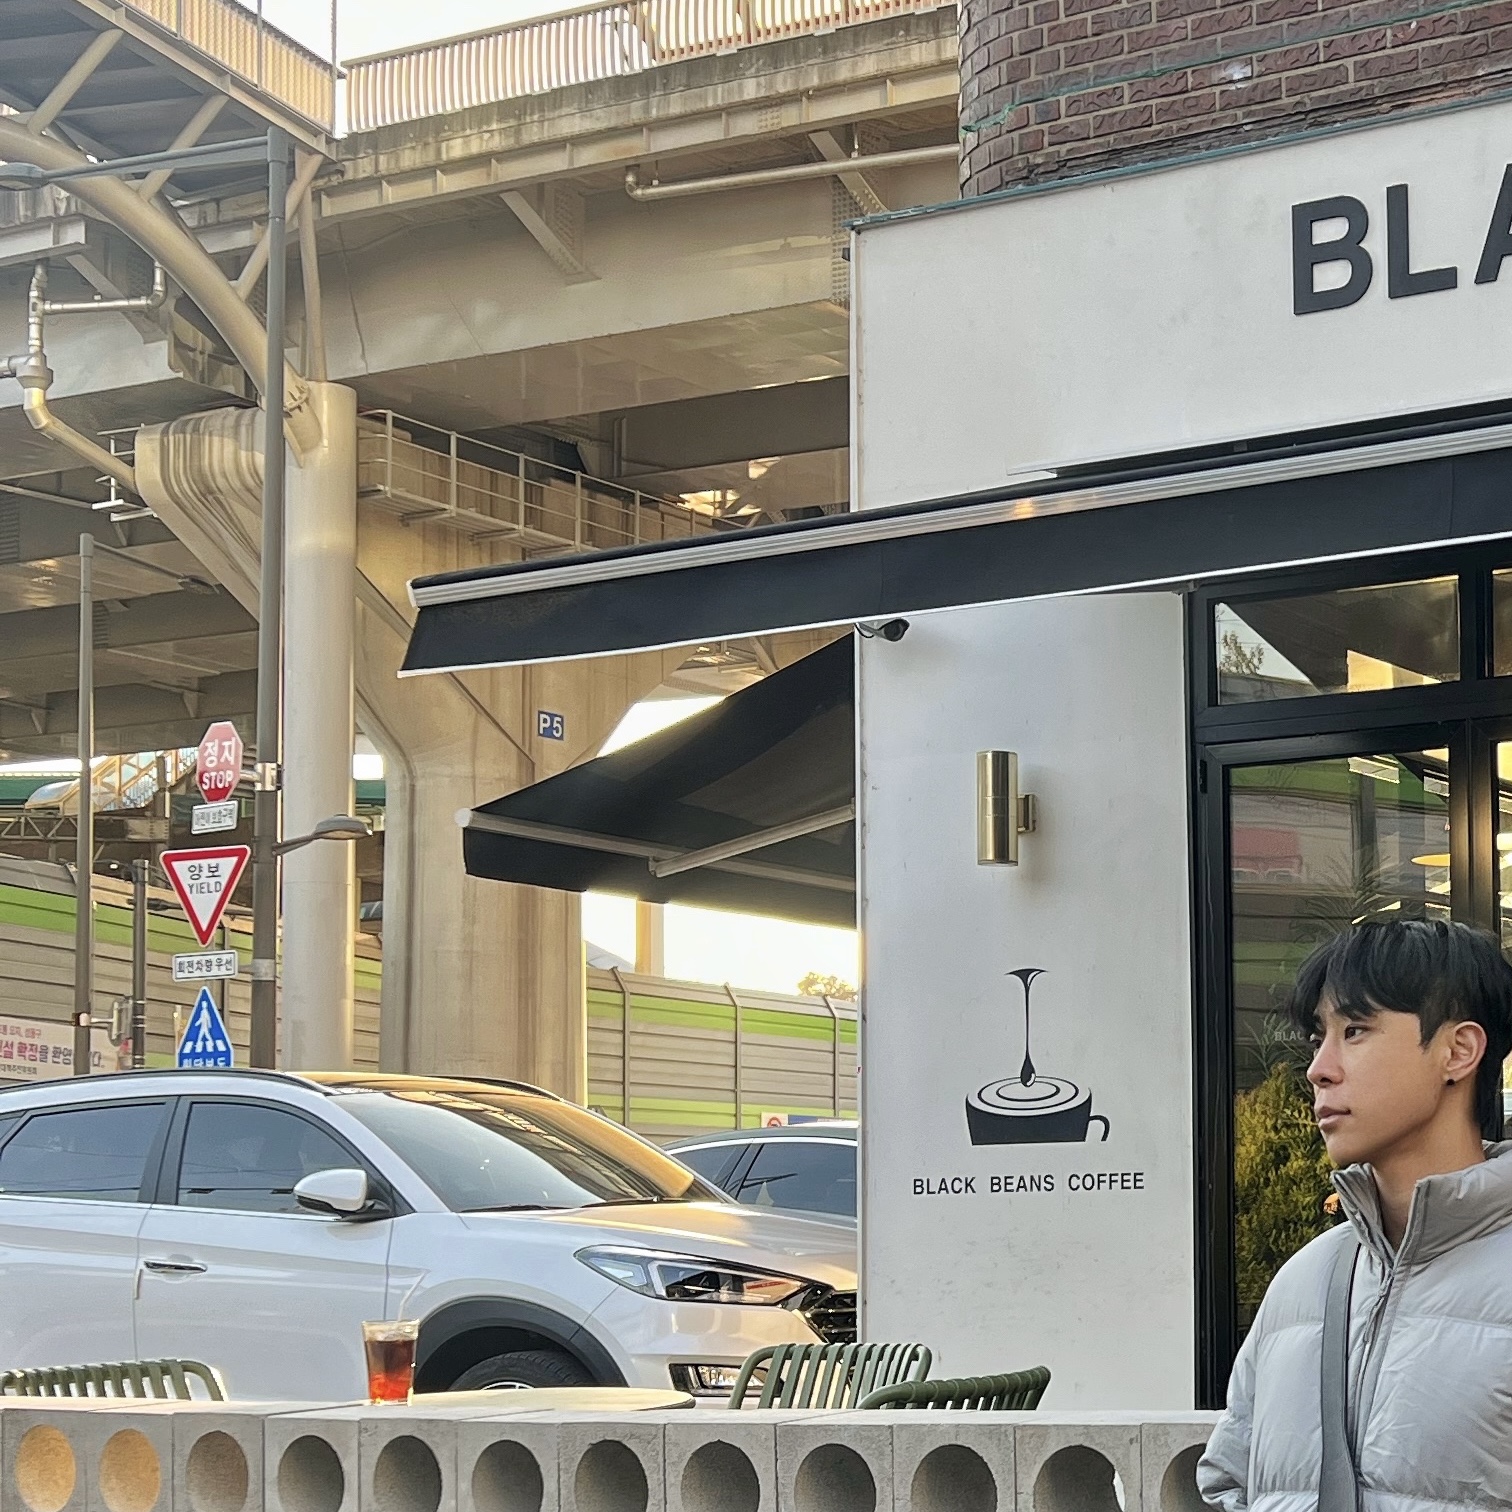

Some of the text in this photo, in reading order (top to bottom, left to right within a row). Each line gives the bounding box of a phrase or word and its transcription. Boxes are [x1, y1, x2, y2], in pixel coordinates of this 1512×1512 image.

[540, 713, 562, 738] P5
[204, 738, 236, 767] 정지
[202, 770, 234, 790] STOP
[188, 863, 221, 880] 양보
[188, 880, 222, 895] YIELD
[1275, 1030, 1305, 1041] BLAC
[17, 1041, 49, 1064] 확정을
[913, 1172, 1145, 1195] BLACK BEANS COFFEE
